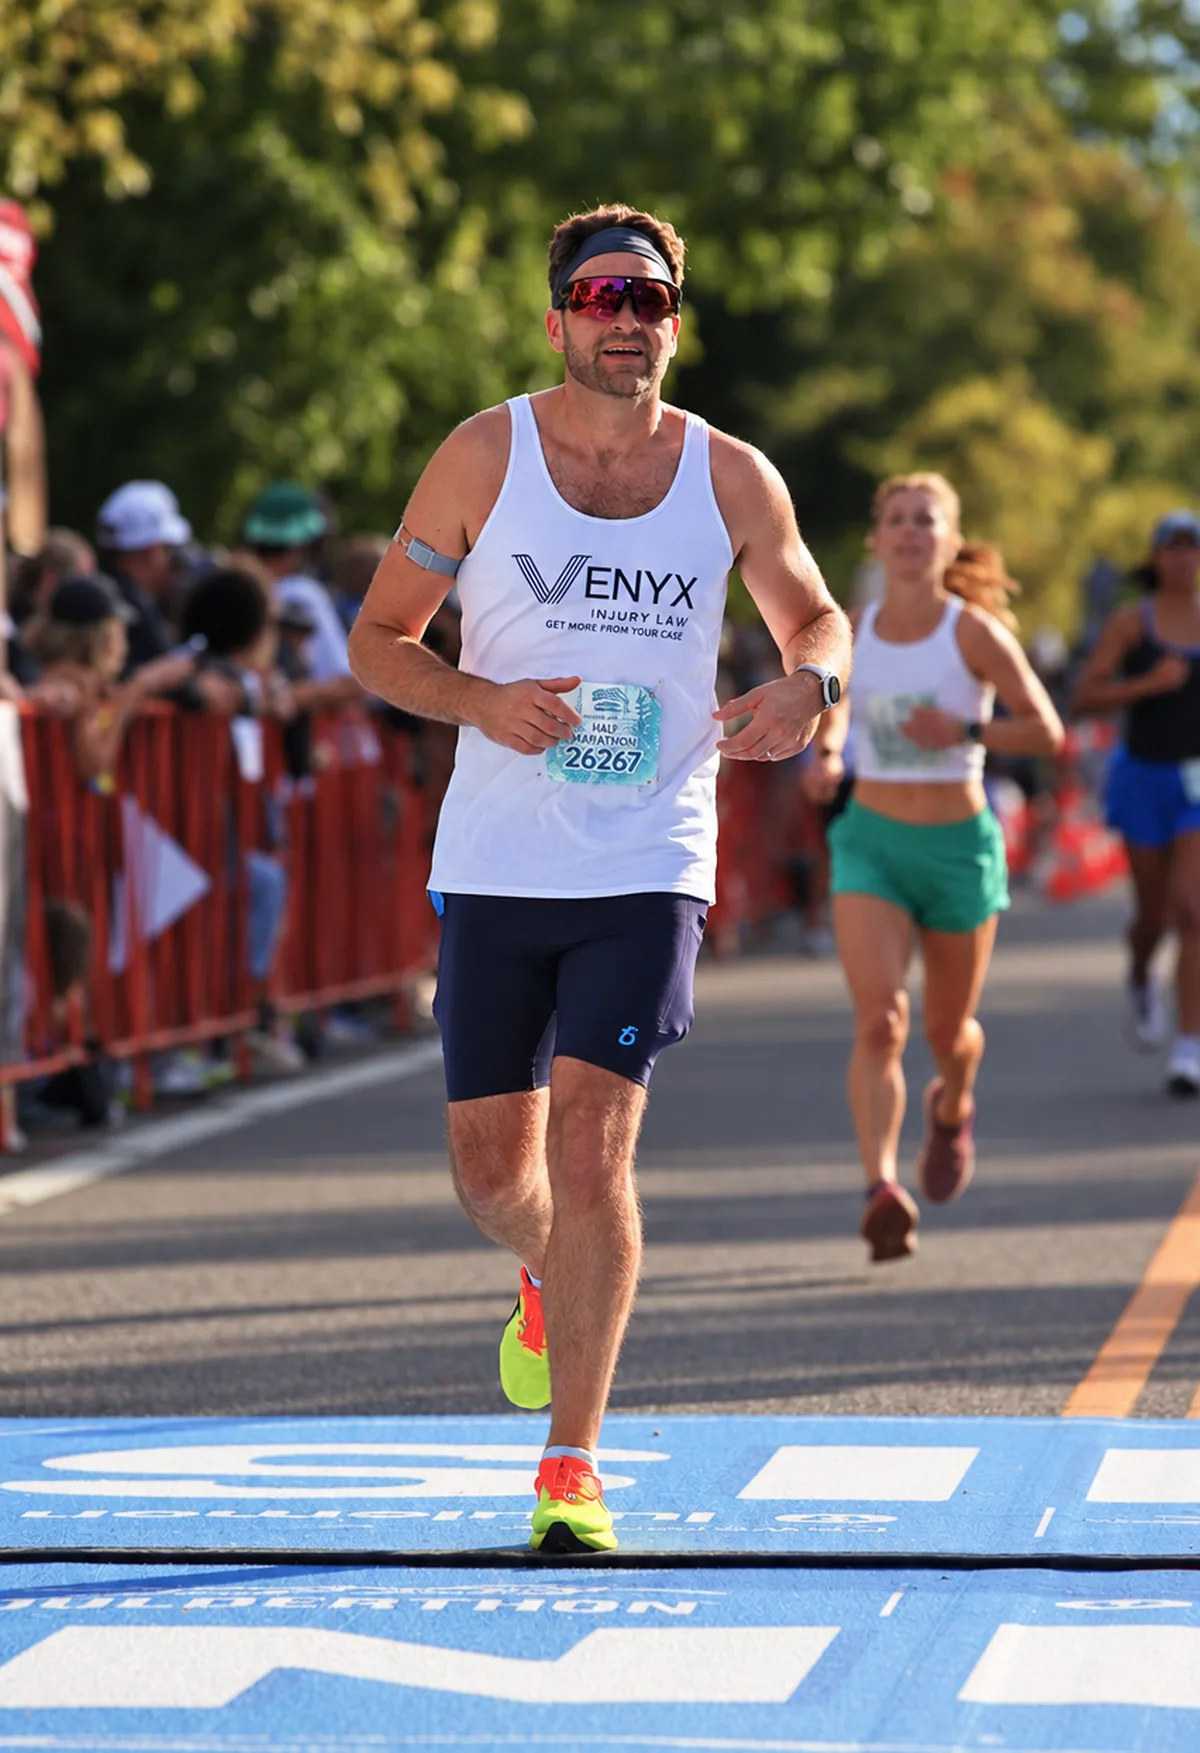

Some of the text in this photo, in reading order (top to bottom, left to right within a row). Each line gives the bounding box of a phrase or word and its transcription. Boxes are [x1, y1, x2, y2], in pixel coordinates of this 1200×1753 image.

[511, 554, 698, 610] VENYX
[591, 608, 689, 628] INJURY LAW
[545, 619, 683, 641] GET MORE FROM YOUR CASE
[571, 733, 637, 748] MARATHON
[565, 746, 642, 773] 26267
